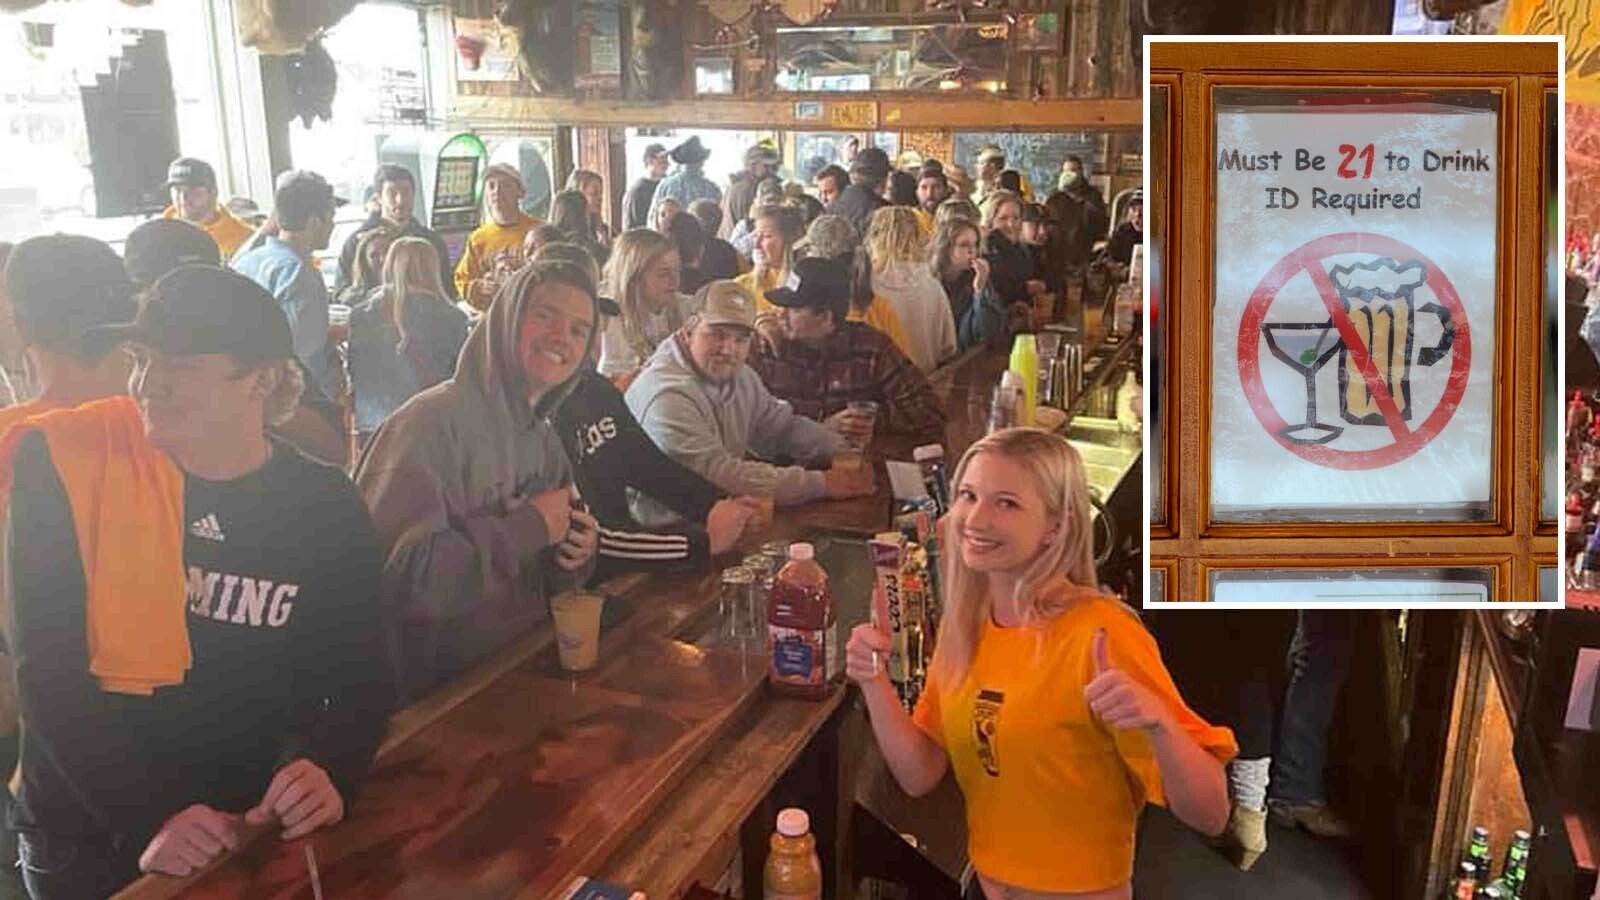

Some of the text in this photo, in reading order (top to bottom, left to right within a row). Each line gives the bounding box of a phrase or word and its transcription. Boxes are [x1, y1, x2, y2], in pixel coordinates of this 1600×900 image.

[1218, 143, 1490, 179] Must Be 21 to Drink
[1265, 186, 1421, 216] ID Required
